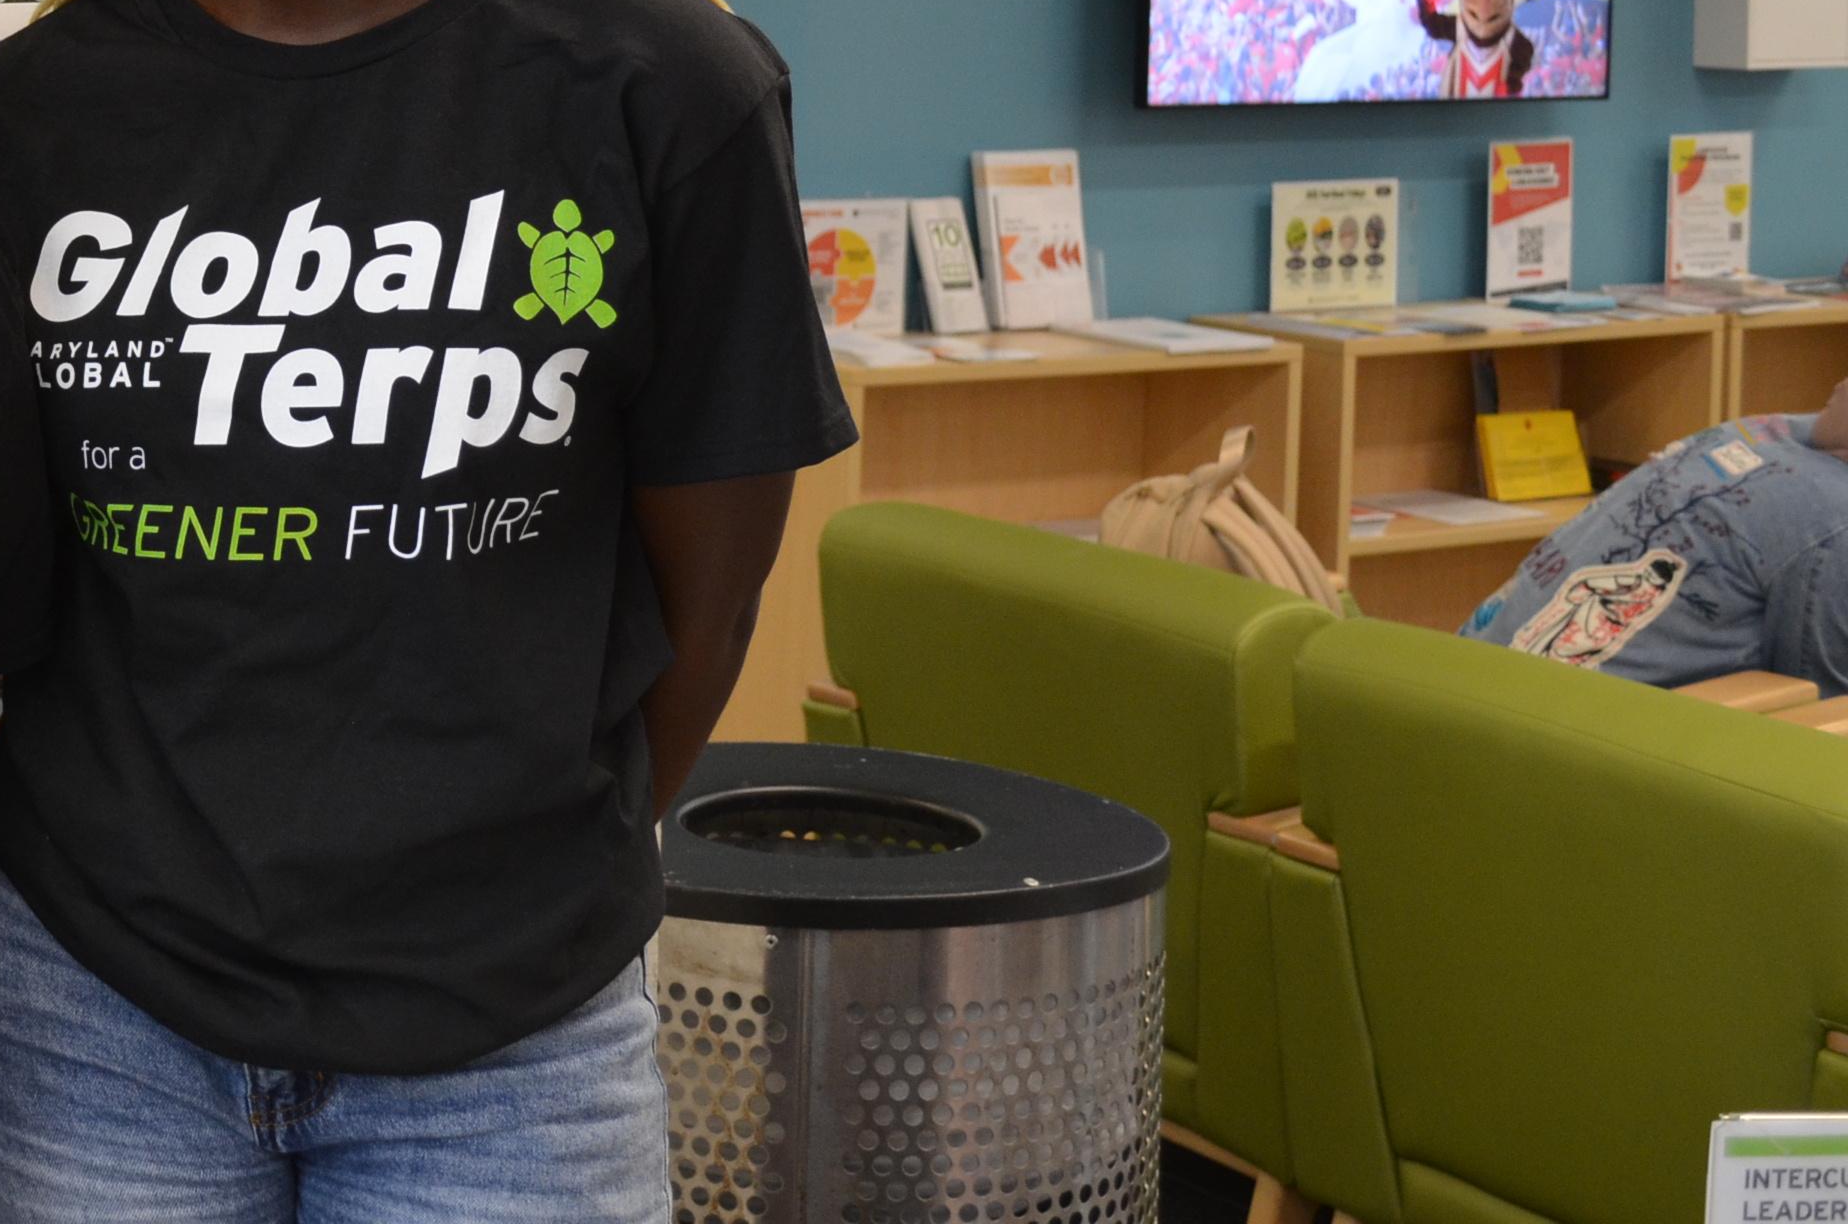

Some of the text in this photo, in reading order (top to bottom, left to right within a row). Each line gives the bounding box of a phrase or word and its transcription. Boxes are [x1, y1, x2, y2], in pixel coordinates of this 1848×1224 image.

[30, 189, 505, 323] Global
[35, 362, 162, 390] LOBAL
[81, 439, 146, 470] for a
[70, 489, 560, 561] GREENER FUTURE
[1743, 1200, 1848, 1221] LEADER
